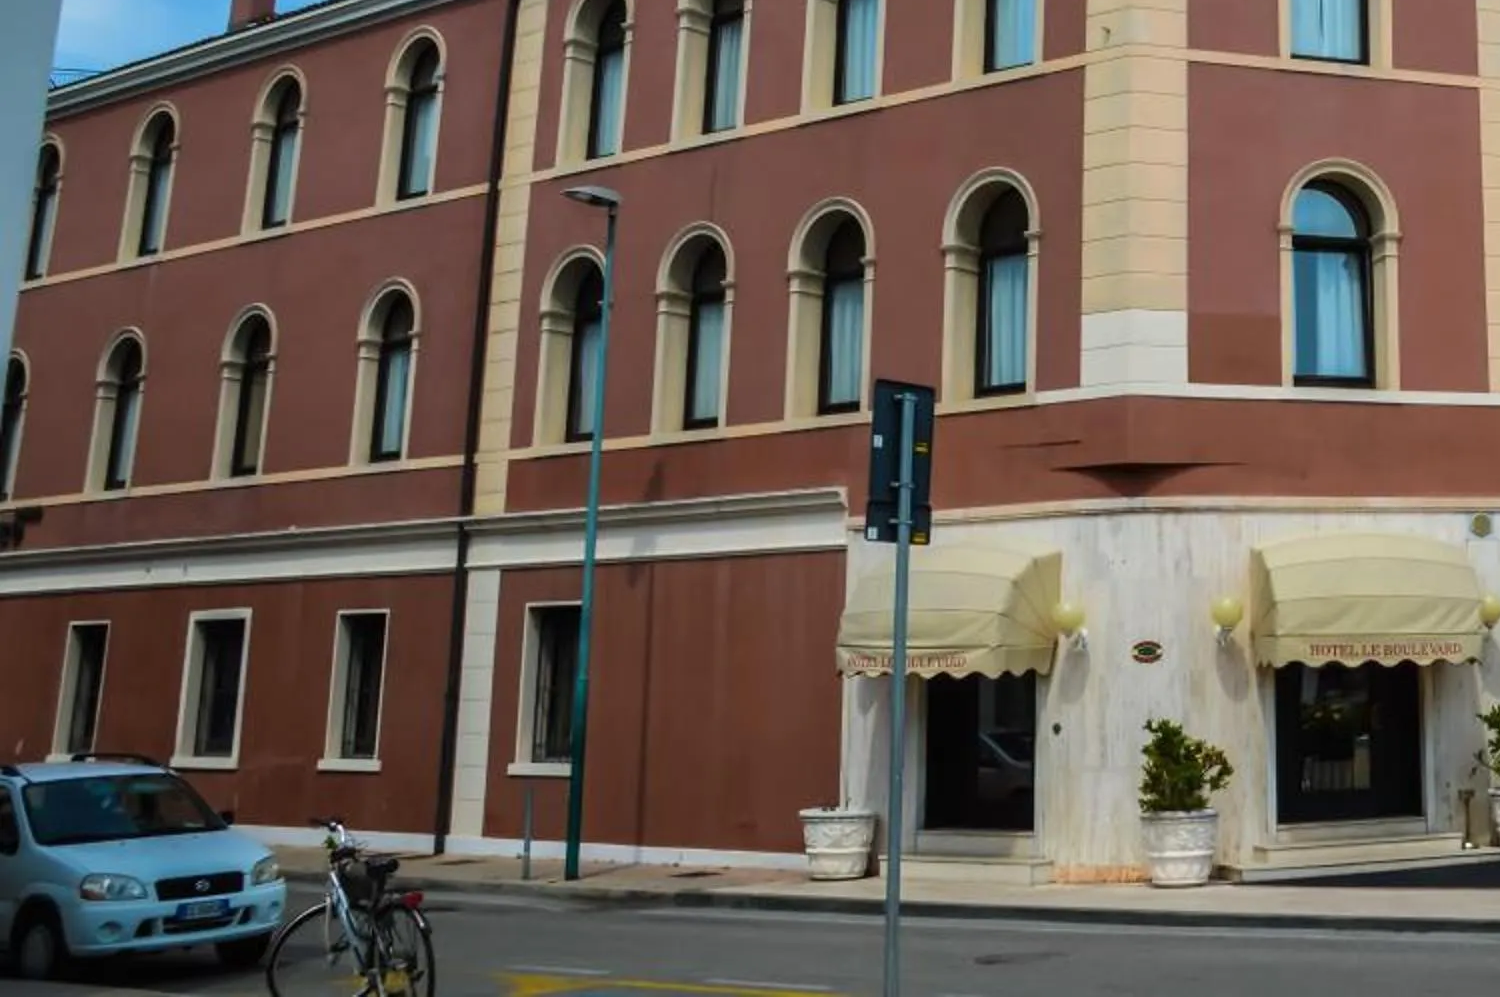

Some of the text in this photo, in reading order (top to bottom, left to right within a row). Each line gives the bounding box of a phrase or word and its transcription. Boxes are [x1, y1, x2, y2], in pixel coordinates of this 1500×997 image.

[1310, 643, 1463, 656] HOTEL LE BOULEVARD
